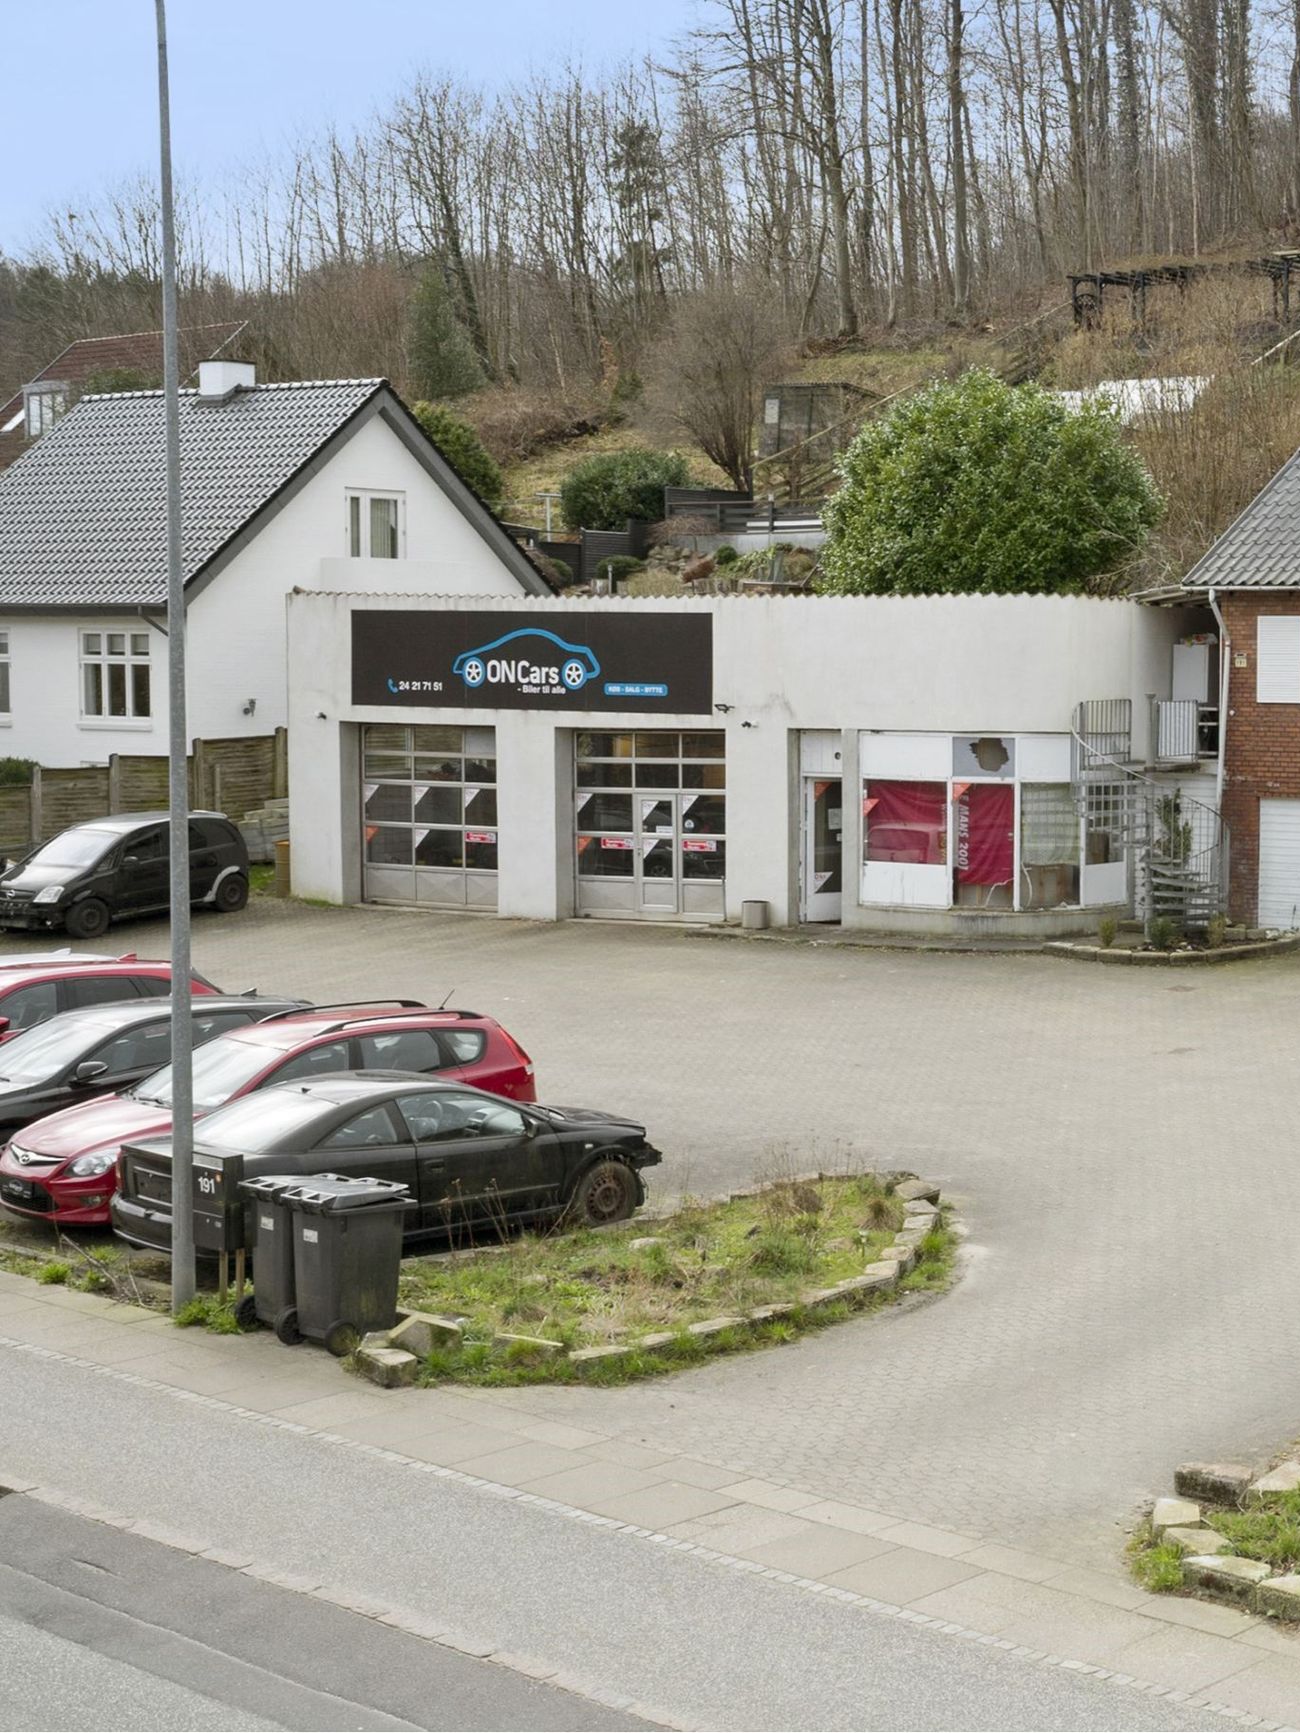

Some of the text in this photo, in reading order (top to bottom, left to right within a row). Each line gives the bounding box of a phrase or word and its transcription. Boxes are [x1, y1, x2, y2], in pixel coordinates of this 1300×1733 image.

[398, 681, 410, 690] 24
[411, 681, 421, 690] 21
[423, 681, 432, 690] 71
[522, 685, 540, 694] Biler
[542, 685, 550, 694] til
[959, 805, 969, 838] MANS
[198, 1176, 215, 1194] 191
